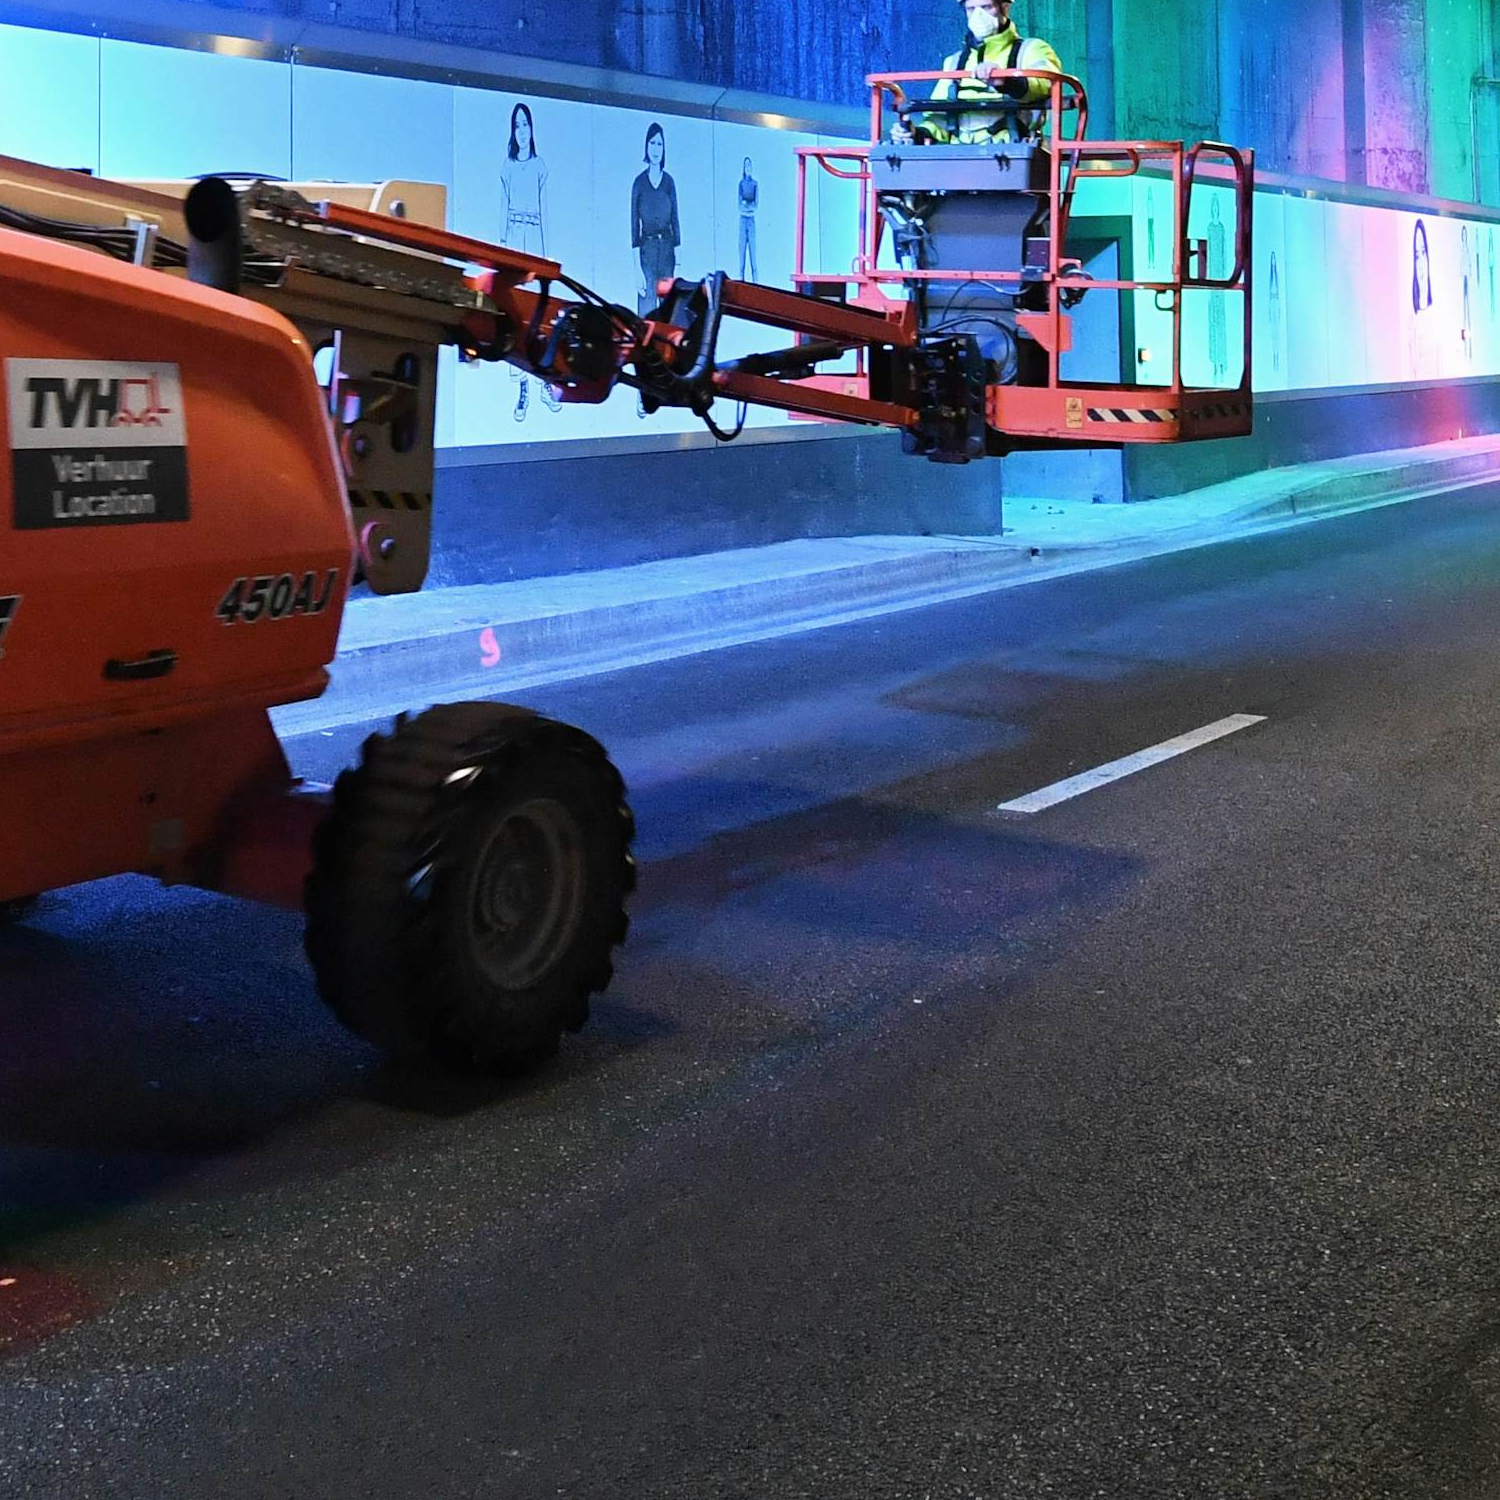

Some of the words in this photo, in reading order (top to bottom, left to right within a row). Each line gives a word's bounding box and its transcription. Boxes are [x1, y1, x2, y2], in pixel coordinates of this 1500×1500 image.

[25, 377, 120, 428] TVH
[52, 454, 153, 483] Verhuur
[53, 487, 156, 518] Location
[215, 568, 340, 626] 450AJ
